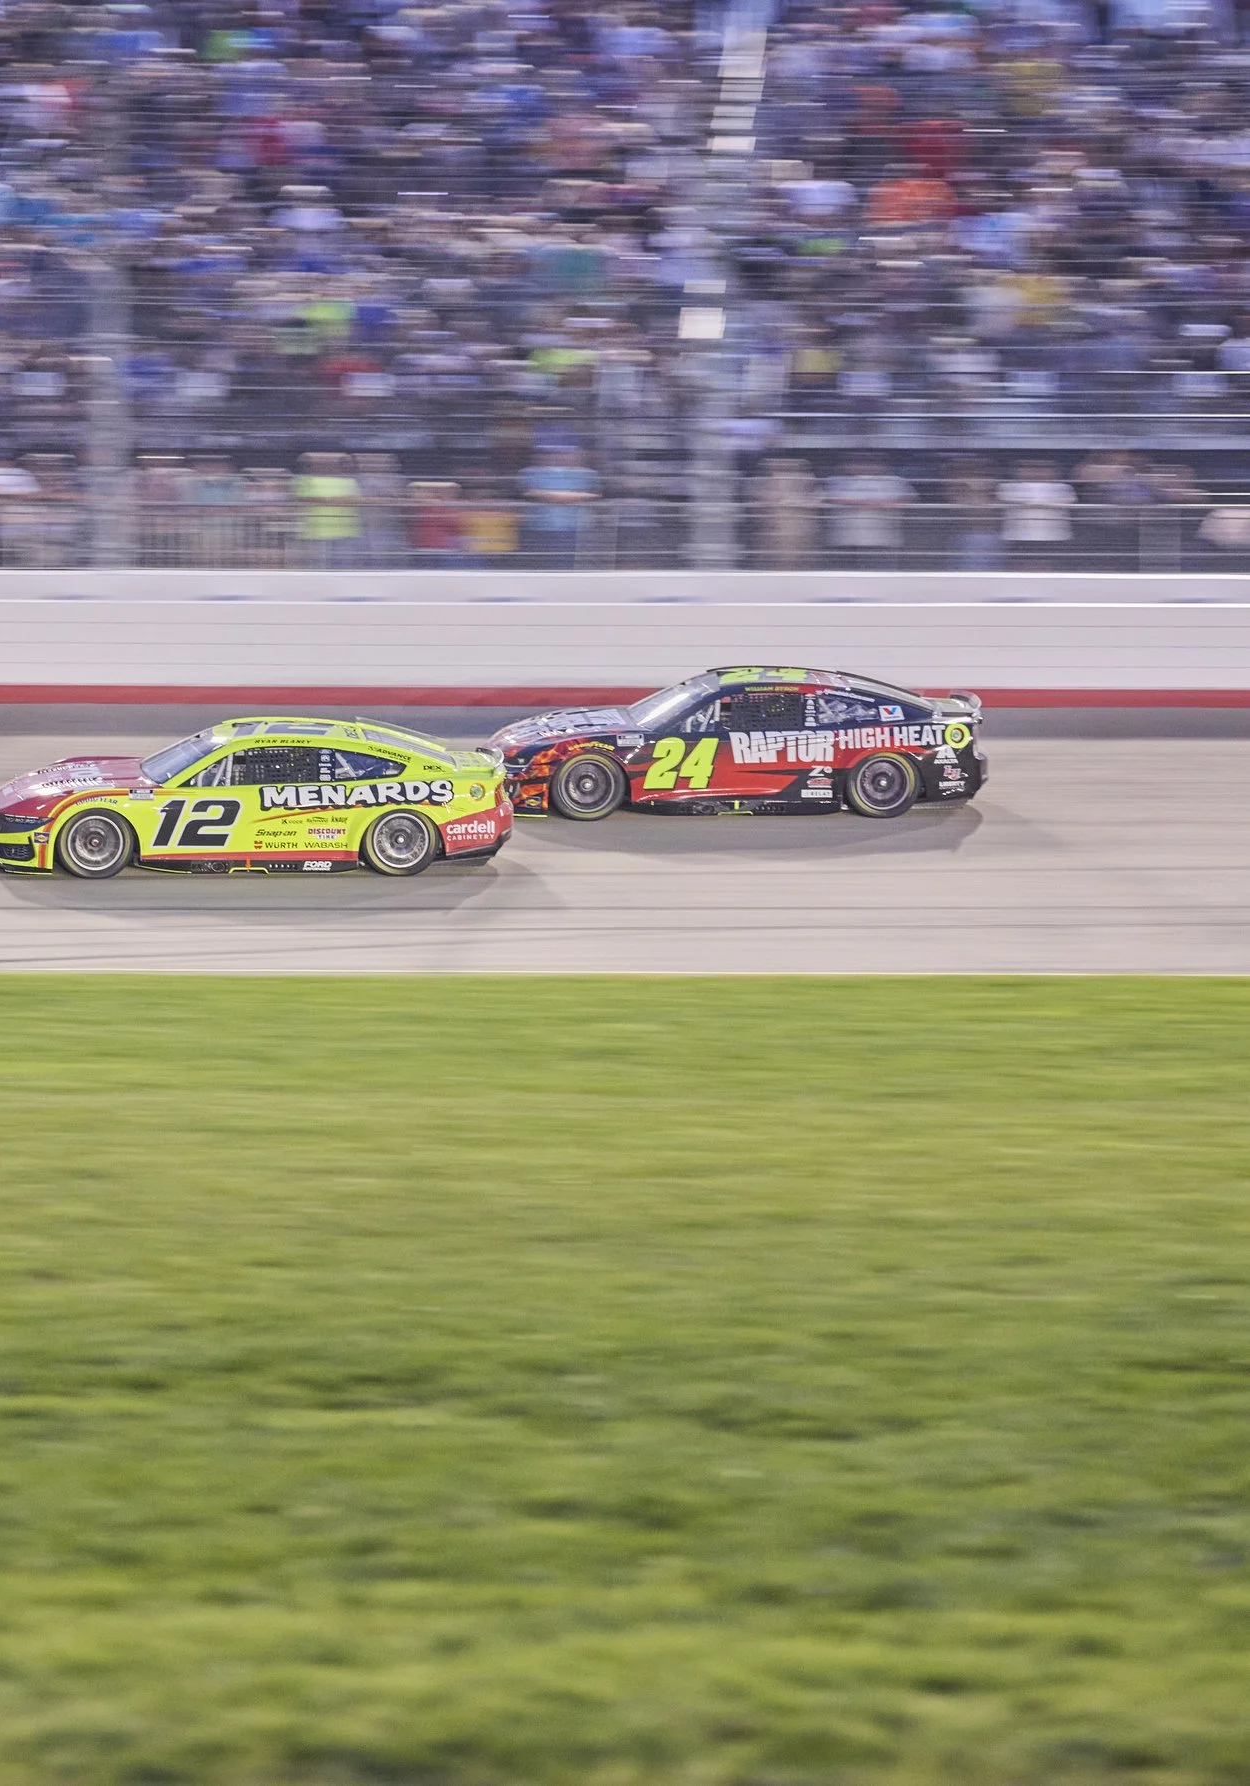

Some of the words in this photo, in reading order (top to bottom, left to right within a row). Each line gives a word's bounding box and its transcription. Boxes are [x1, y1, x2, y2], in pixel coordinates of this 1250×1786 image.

[377, 748, 411, 761] ADVANCE
[729, 730, 834, 764] RAPTOR
[838, 726, 890, 750] HIGH
[893, 725, 946, 747] HEAT
[643, 737, 719, 790] 24
[260, 780, 454, 809] MENARDS
[151, 798, 242, 849] 12
[255, 829, 297, 837] Snap-on
[446, 820, 495, 834] cardell
